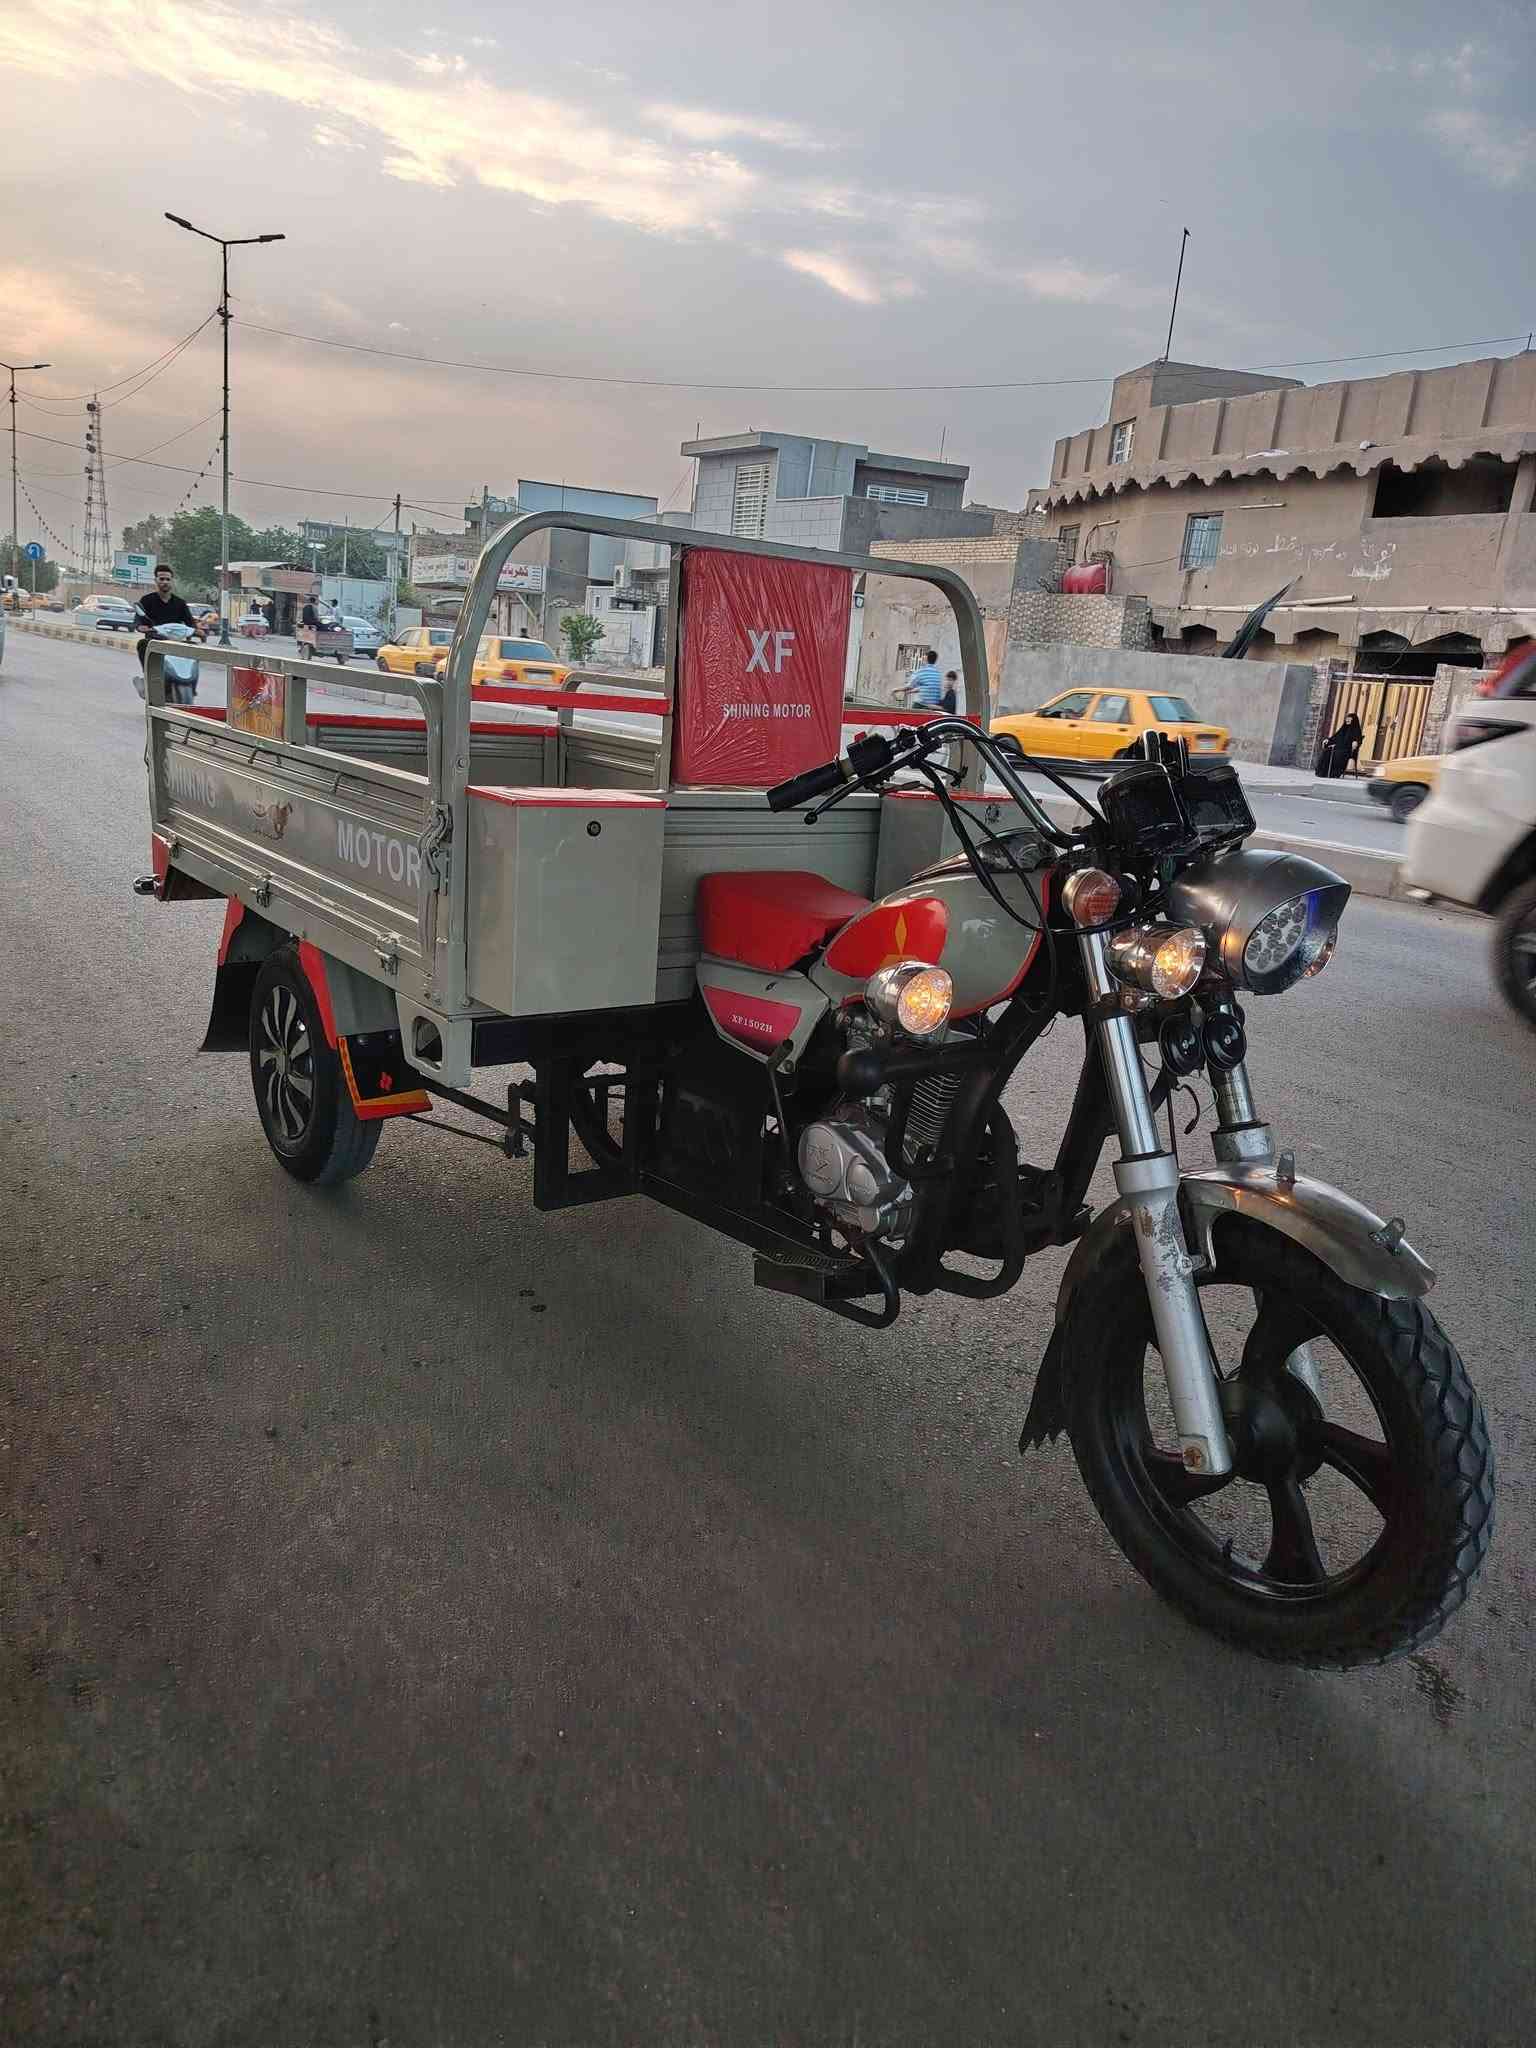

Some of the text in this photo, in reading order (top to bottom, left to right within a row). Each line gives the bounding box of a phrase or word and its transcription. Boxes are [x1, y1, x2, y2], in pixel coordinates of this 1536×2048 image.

[745, 629, 795, 673] XF
[722, 702, 812, 719] SHINING MOTOR
[336, 818, 422, 889] MOTOR
